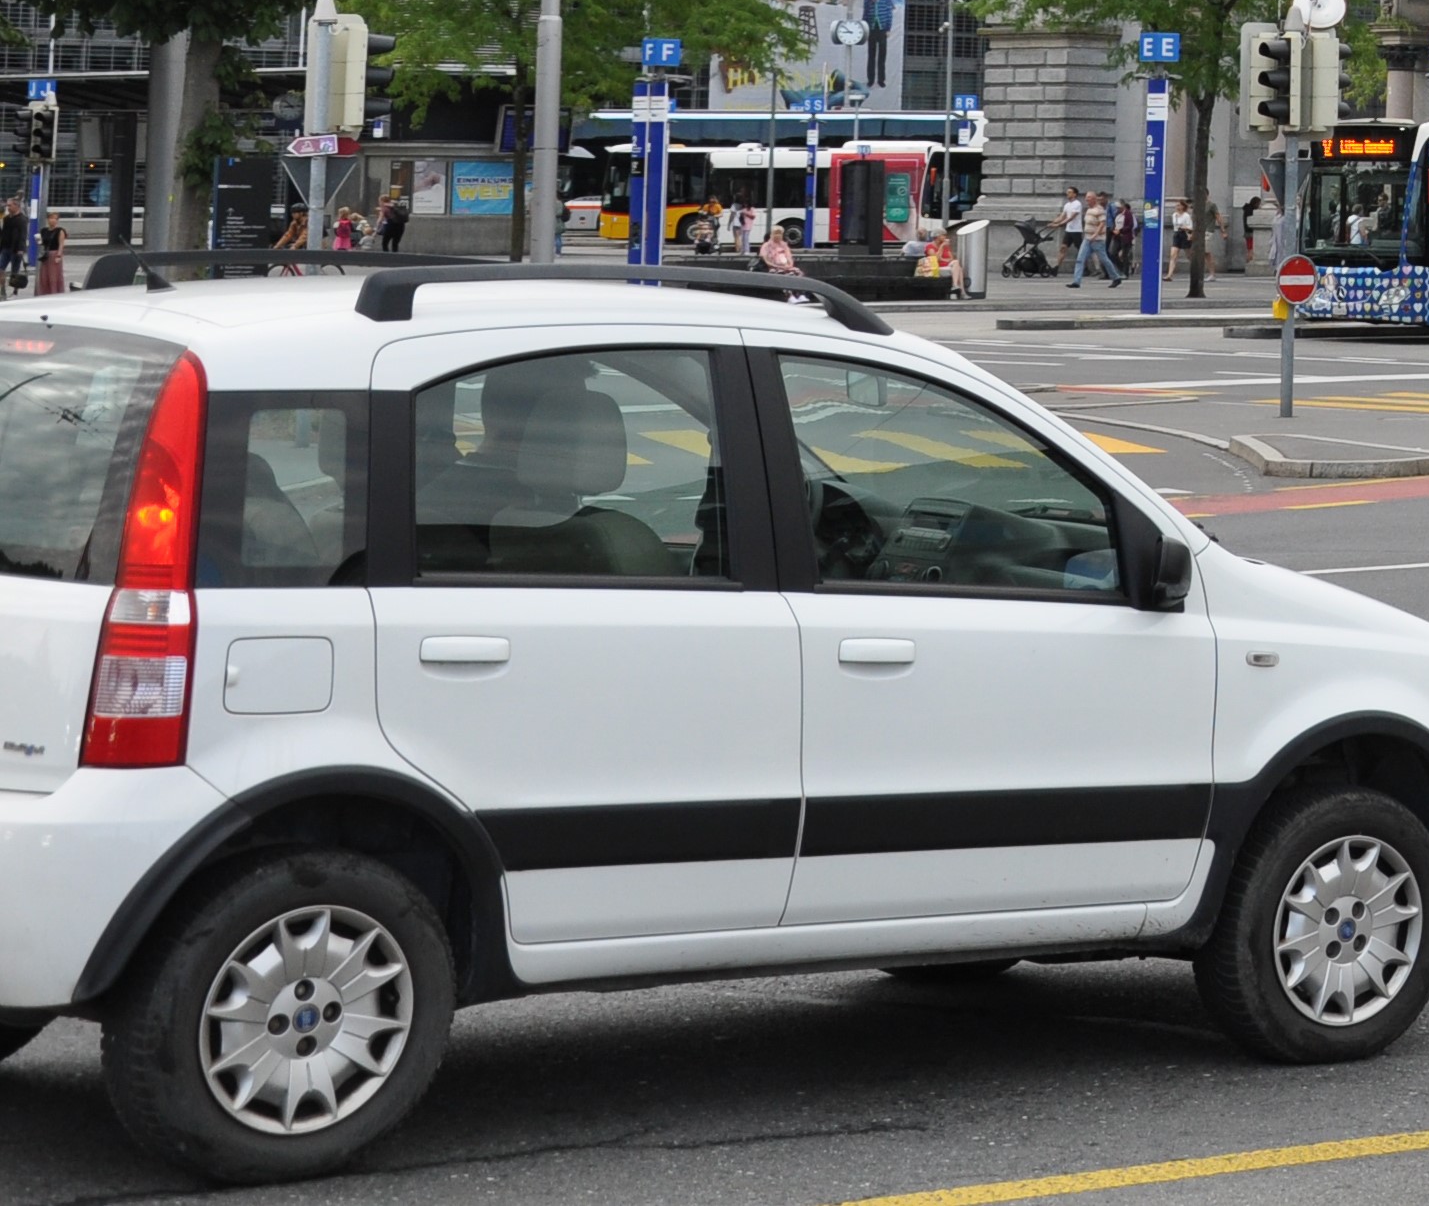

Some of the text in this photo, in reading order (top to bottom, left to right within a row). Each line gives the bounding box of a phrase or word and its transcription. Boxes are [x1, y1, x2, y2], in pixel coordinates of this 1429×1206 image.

[645, 43, 674, 61] F F
[1143, 37, 1174, 56] E E
[29, 82, 35, 96] J
[804, 99, 811, 111] S
[814, 99, 822, 111] S
[965, 97, 974, 109] R
[1146, 135, 1153, 147] 9
[1146, 156, 1155, 167] 11
[456, 184, 512, 200] WELT
